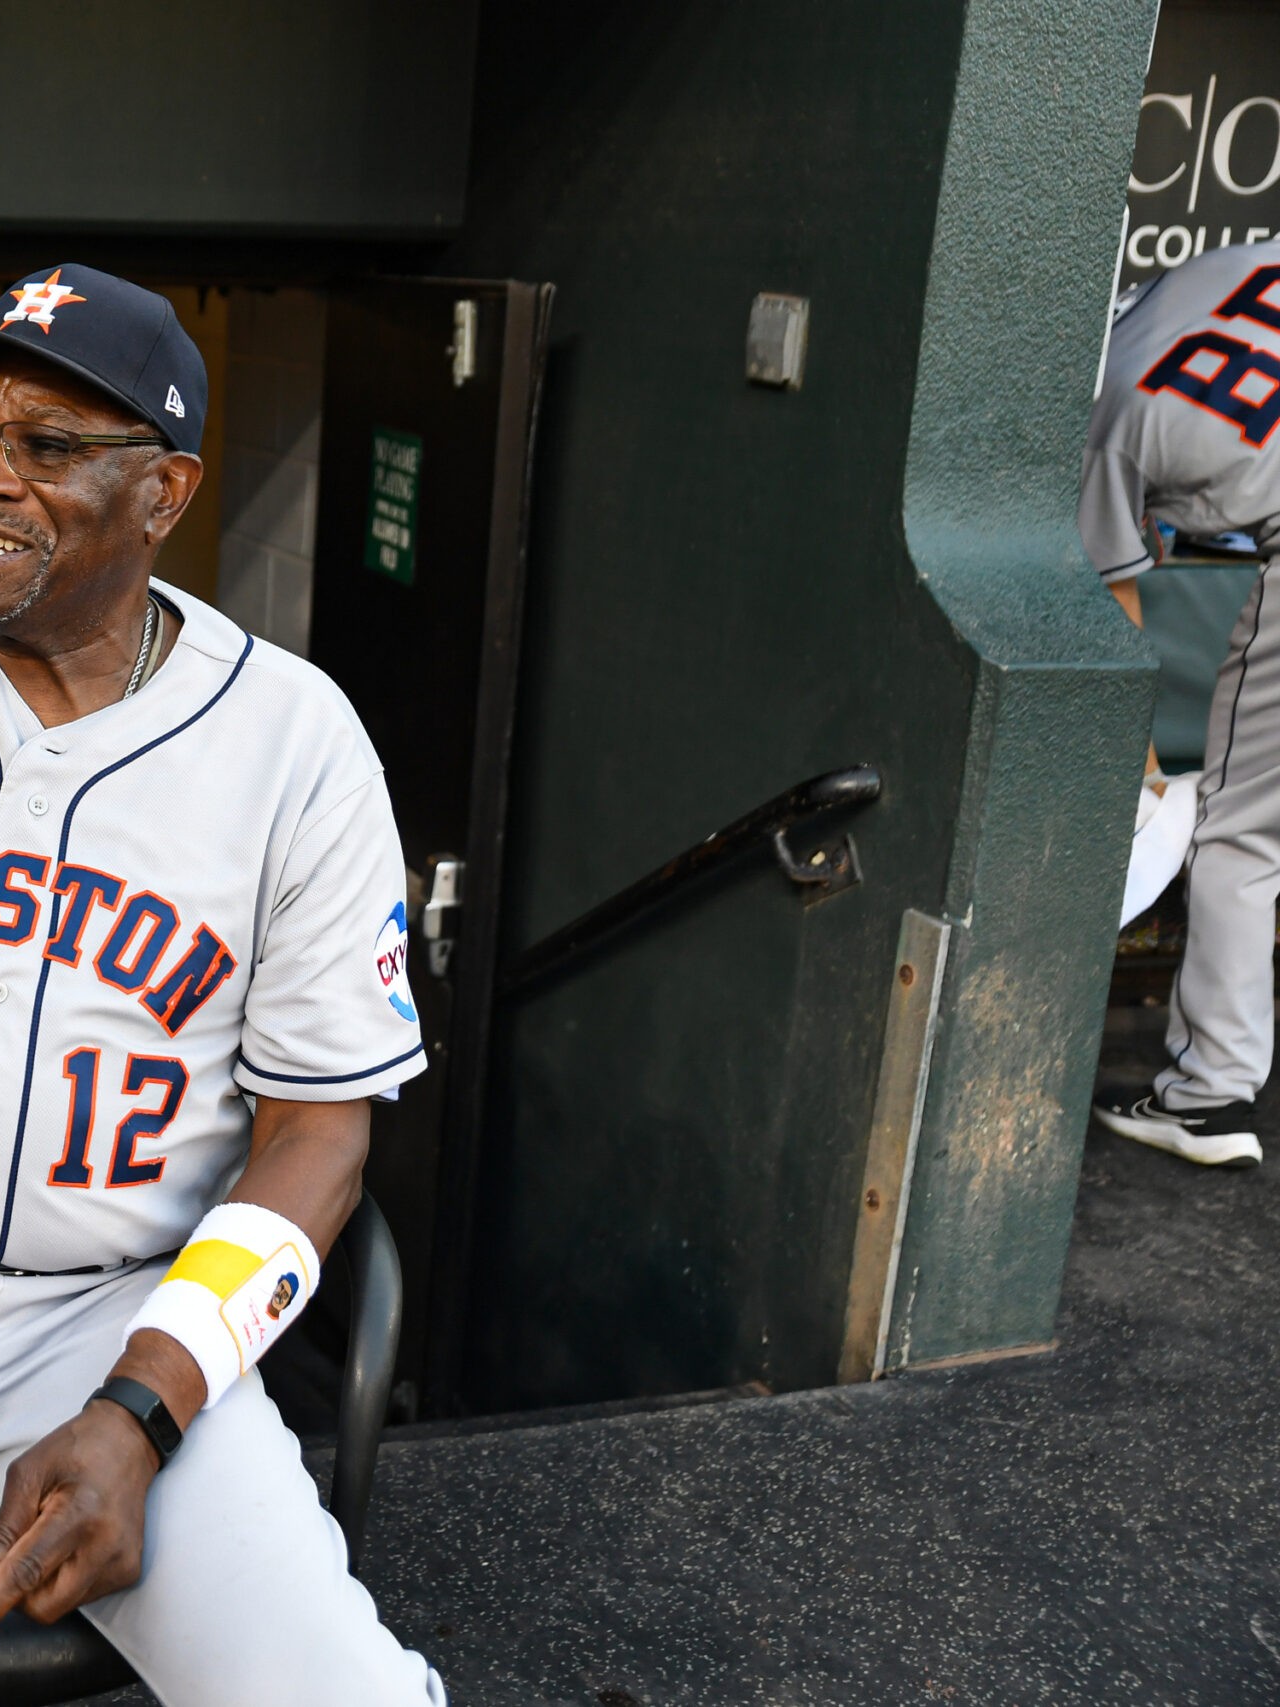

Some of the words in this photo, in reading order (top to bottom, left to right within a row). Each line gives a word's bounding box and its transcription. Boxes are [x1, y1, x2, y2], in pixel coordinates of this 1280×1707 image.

[1125, 224, 1280, 268] COL
[3, 282, 73, 325] H
[47, 1046, 190, 1189] 12
